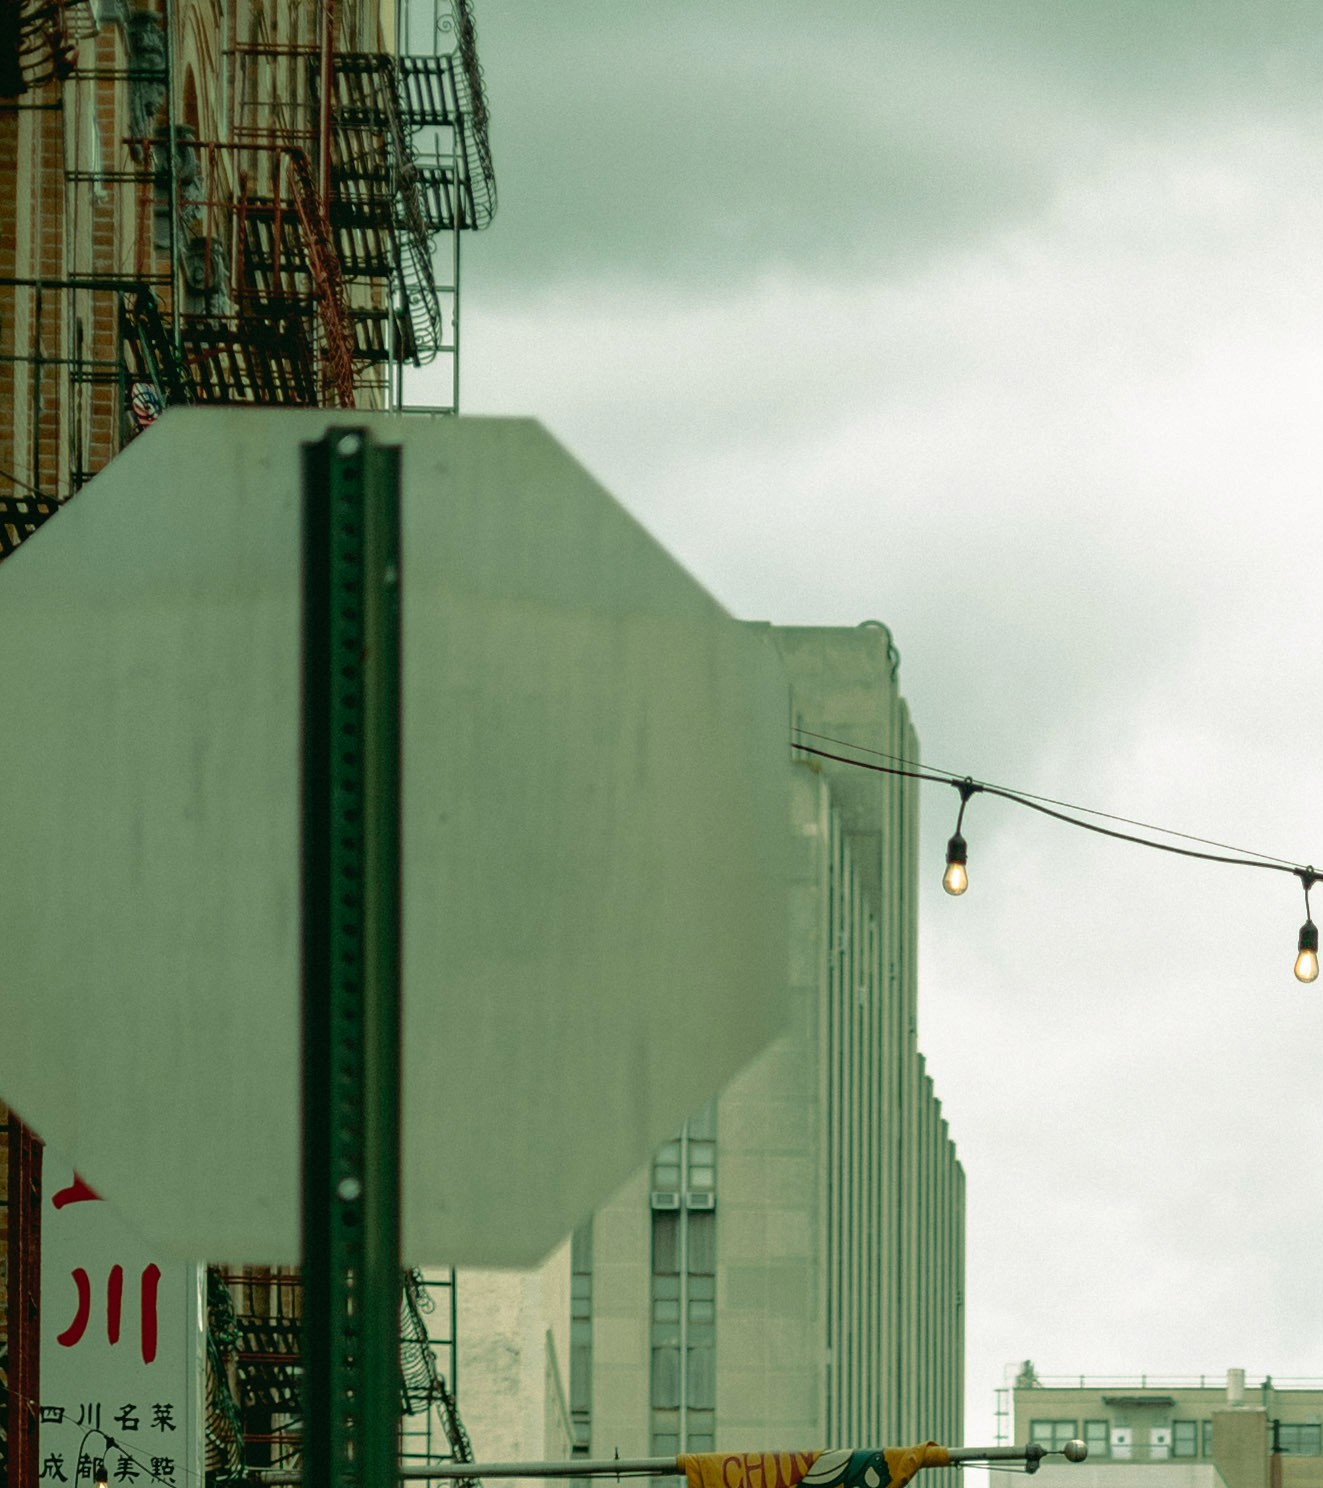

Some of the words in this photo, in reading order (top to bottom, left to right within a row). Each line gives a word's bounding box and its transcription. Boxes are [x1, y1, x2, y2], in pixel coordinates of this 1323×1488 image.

[40, 1403, 176, 1432] 四川名菜
[39, 1452, 176, 1485] 成都美點
